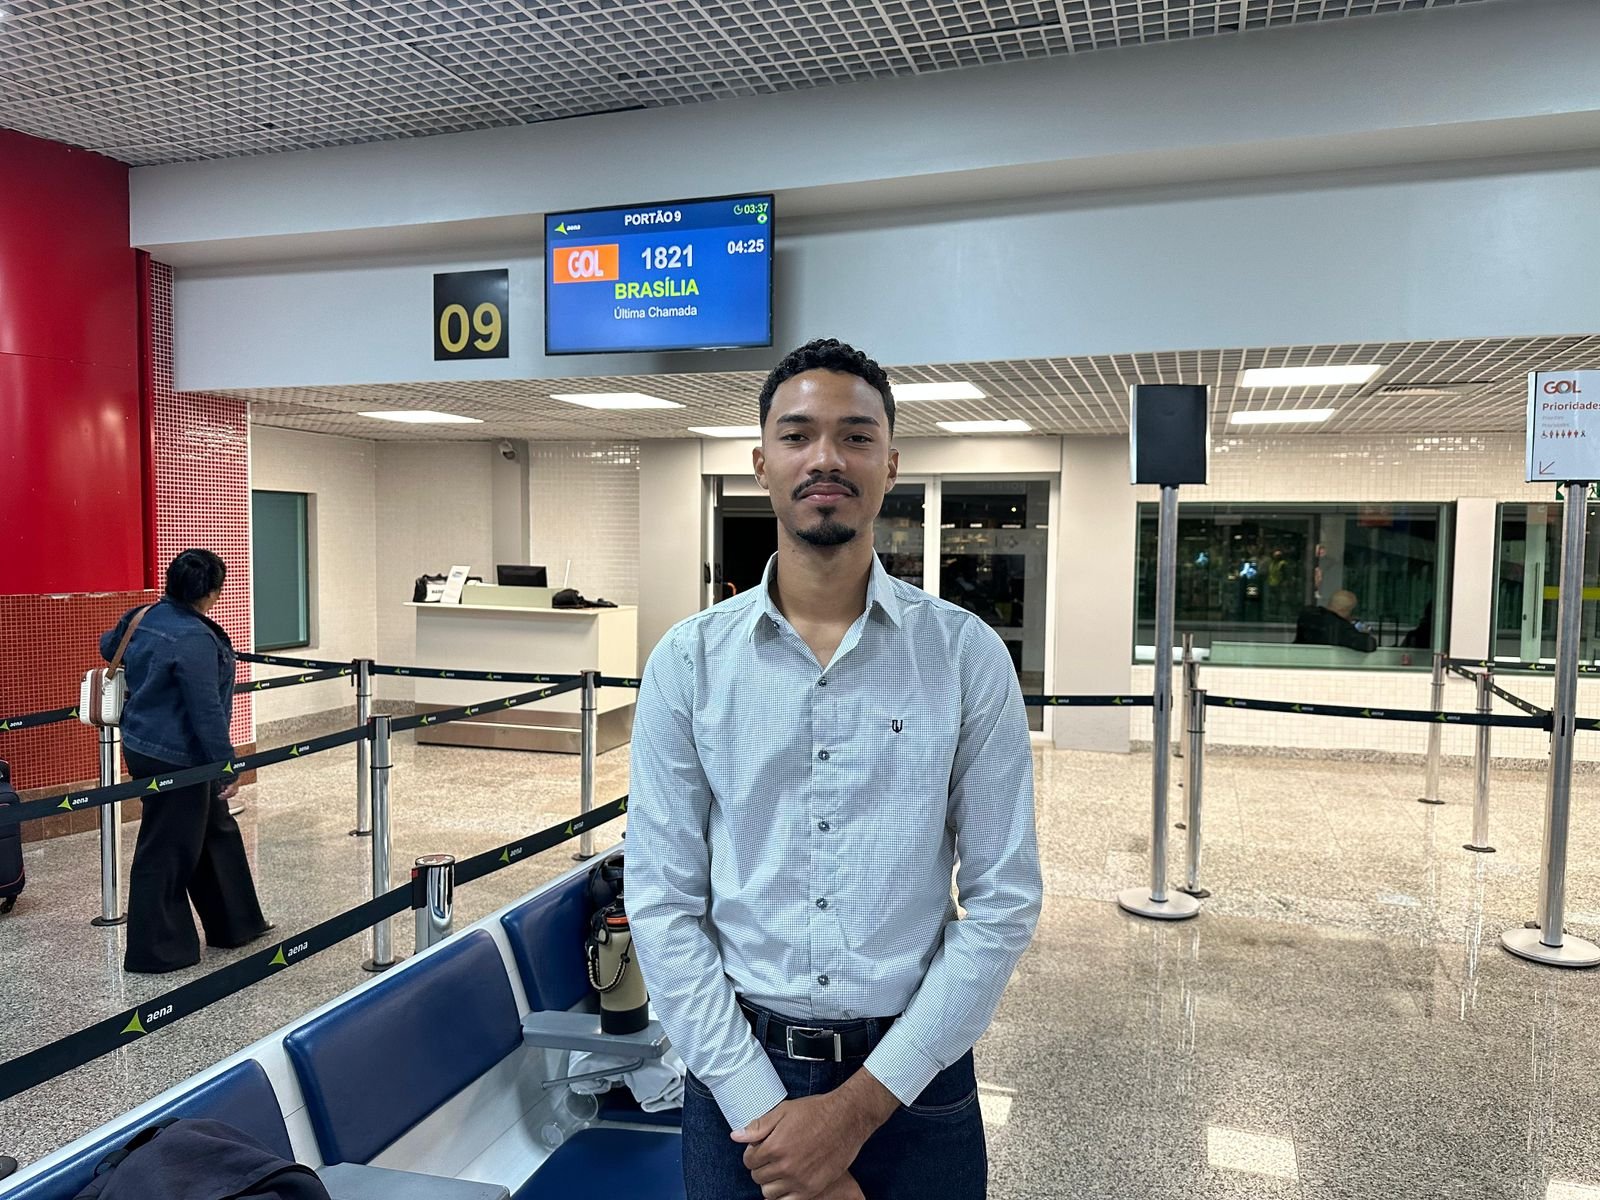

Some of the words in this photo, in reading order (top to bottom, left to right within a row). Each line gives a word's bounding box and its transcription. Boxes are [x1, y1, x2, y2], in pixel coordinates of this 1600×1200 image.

[744, 203, 769, 214] 03:37
[624, 210, 673, 226] PORTÃO
[674, 211, 682, 222] 9
[727, 239, 765, 254] 04:25
[567, 249, 604, 279] GOL
[641, 244, 693, 270] 1821
[614, 276, 699, 300] BRASÍLIA
[614, 306, 645, 320] Última
[648, 305, 698, 319] Chamada
[440, 303, 502, 353] 09
[1543, 380, 1582, 395] GOL
[159, 777, 174, 787] aena
[72, 796, 89, 805] aena
[287, 940, 309, 957] aena
[146, 1004, 173, 1023] aena
